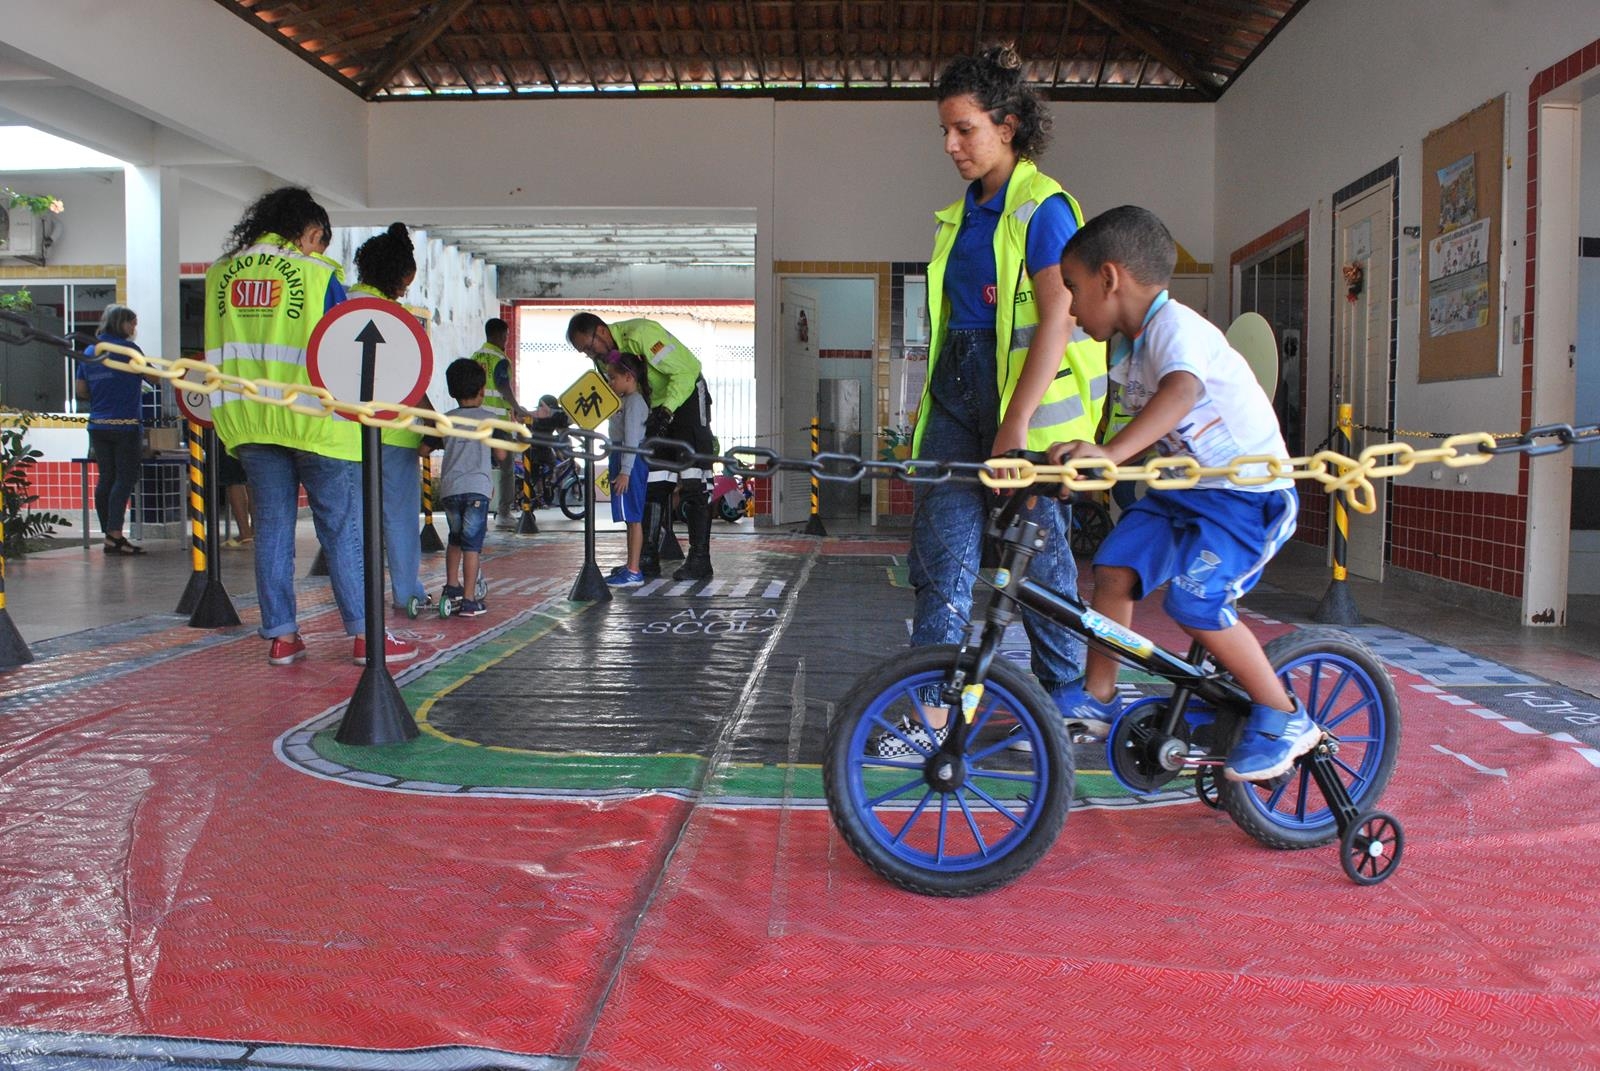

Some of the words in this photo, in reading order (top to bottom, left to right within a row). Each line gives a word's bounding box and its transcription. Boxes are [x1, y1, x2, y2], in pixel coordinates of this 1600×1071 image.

[217, 254, 254, 317] EDUCAÇÃO
[258, 253, 275, 266] DE
[274, 258, 304, 319] TRÂNSITO
[236, 280, 272, 306] STTU
